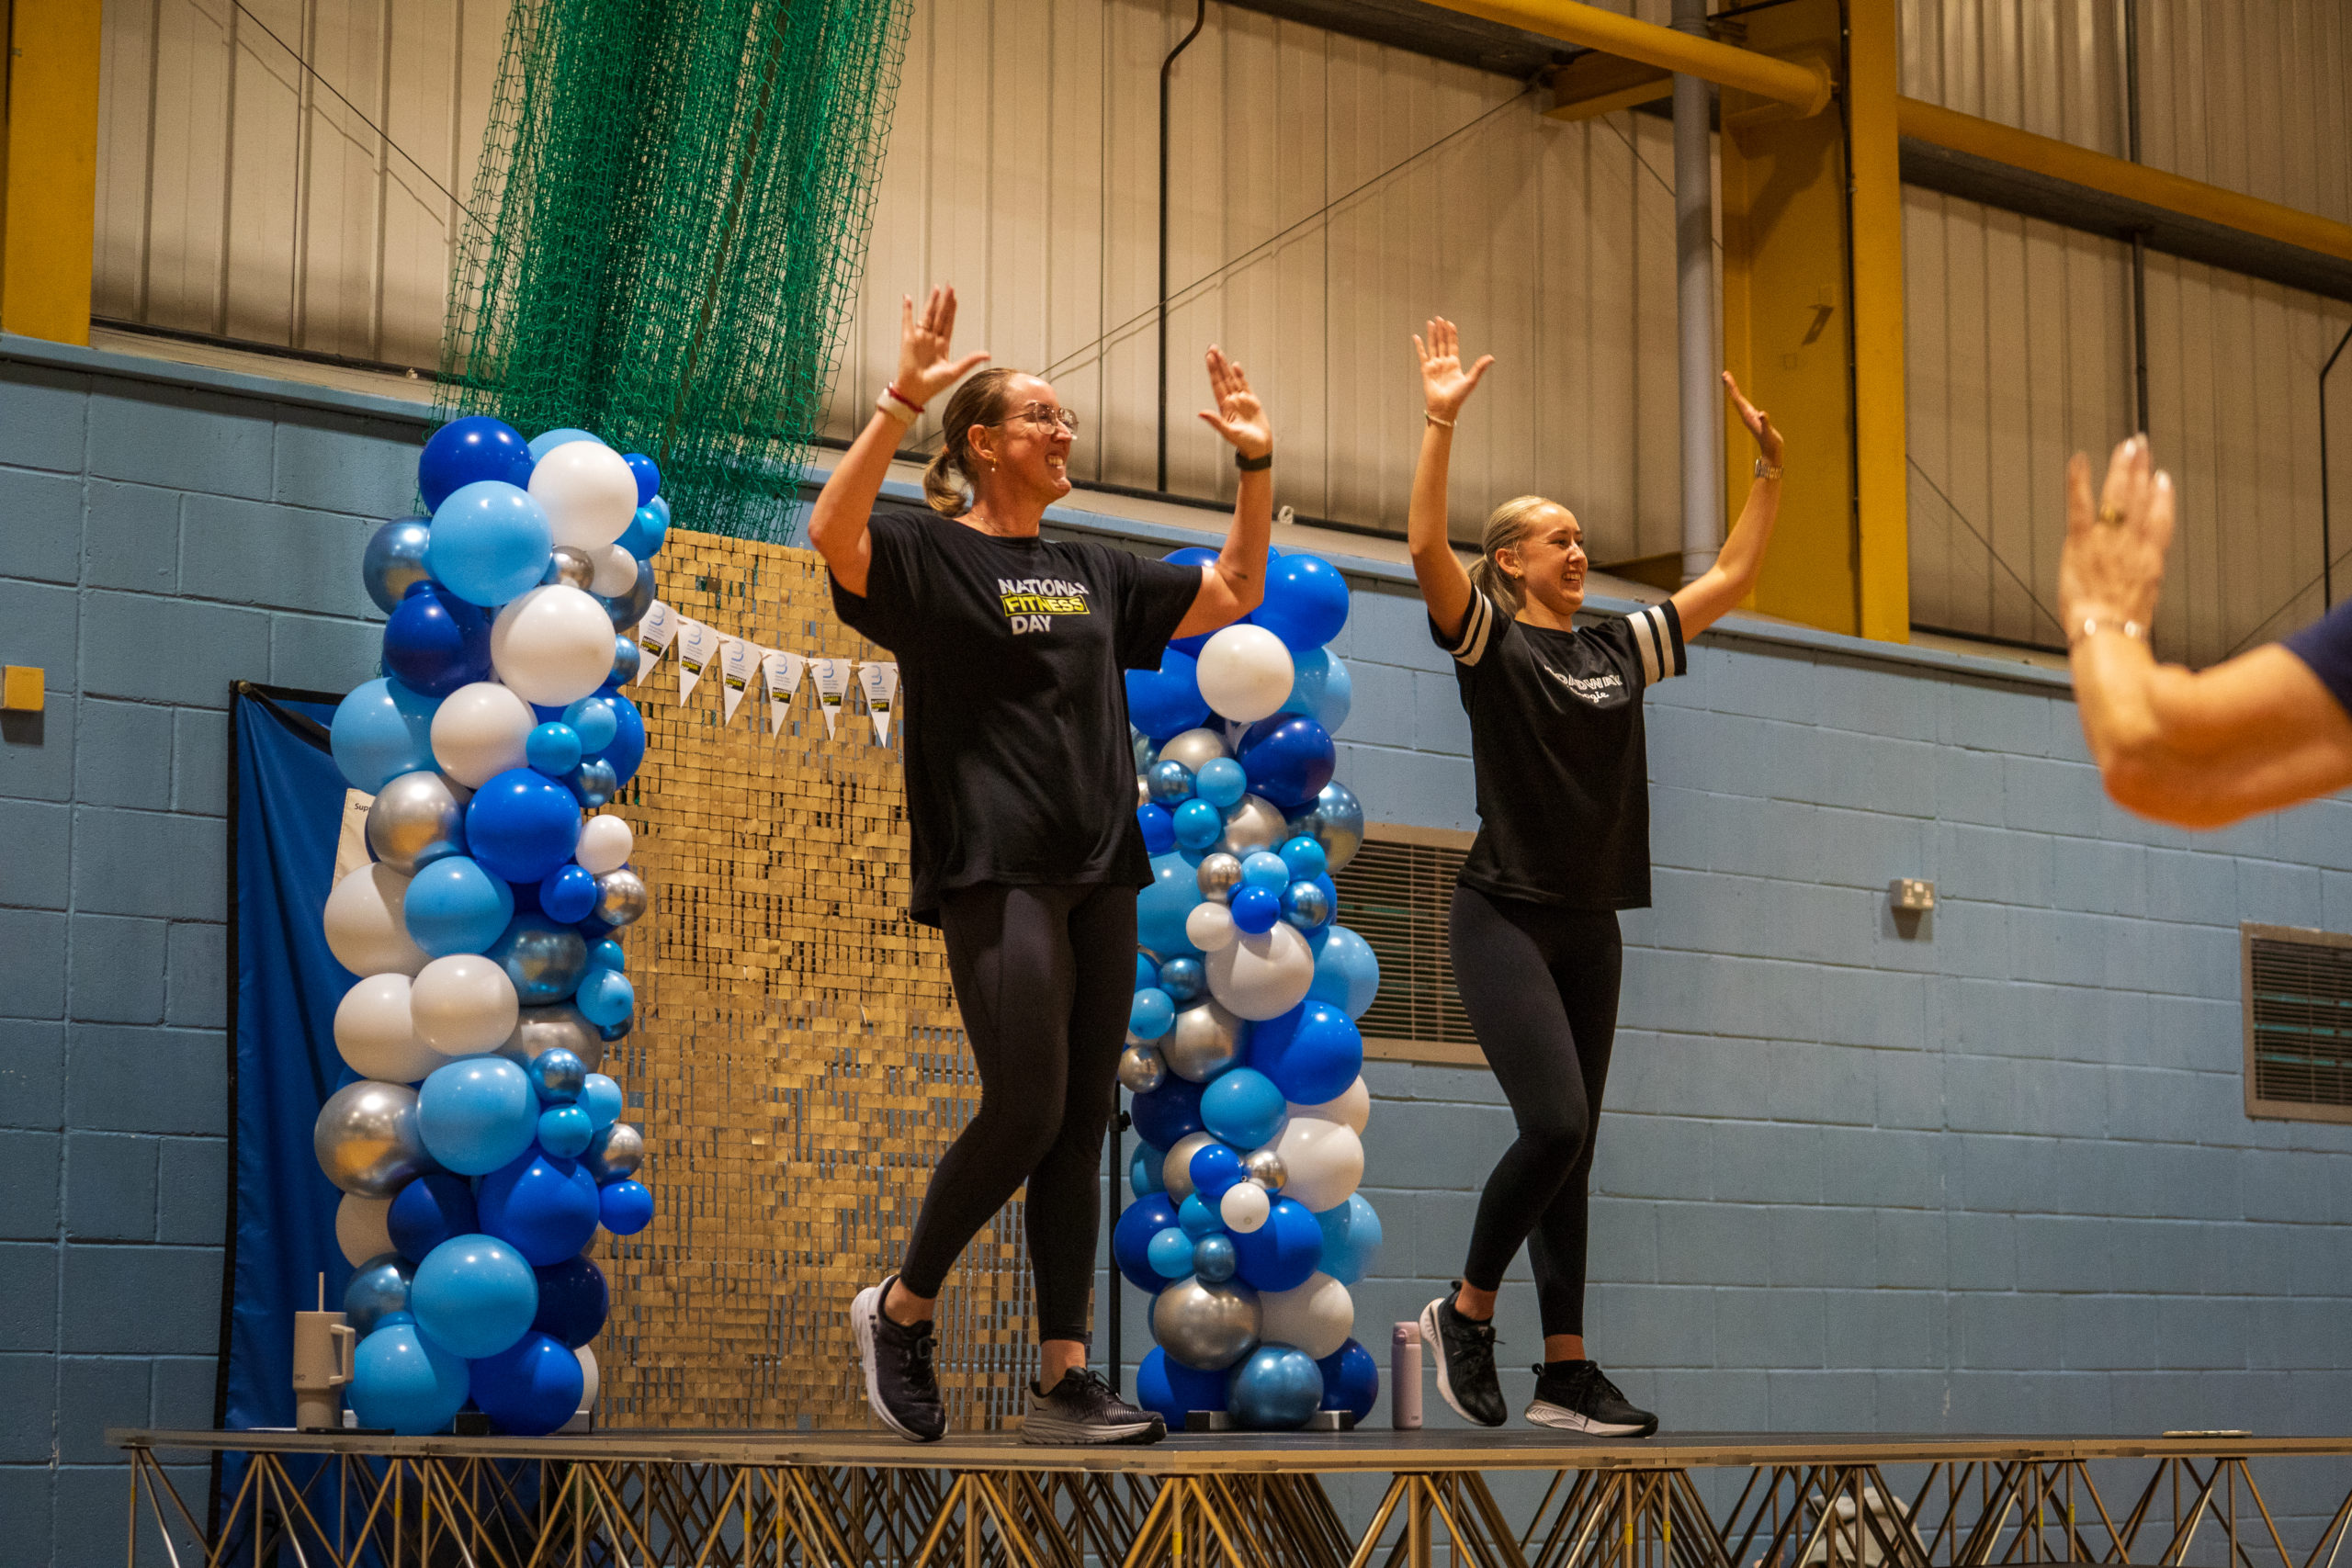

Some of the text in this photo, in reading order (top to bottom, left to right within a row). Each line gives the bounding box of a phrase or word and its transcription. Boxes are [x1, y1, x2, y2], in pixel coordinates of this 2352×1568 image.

[1004, 596, 1085, 613] FITNESS
[1011, 615, 1052, 636] DAY
[1544, 664, 1623, 691] OADWAY
